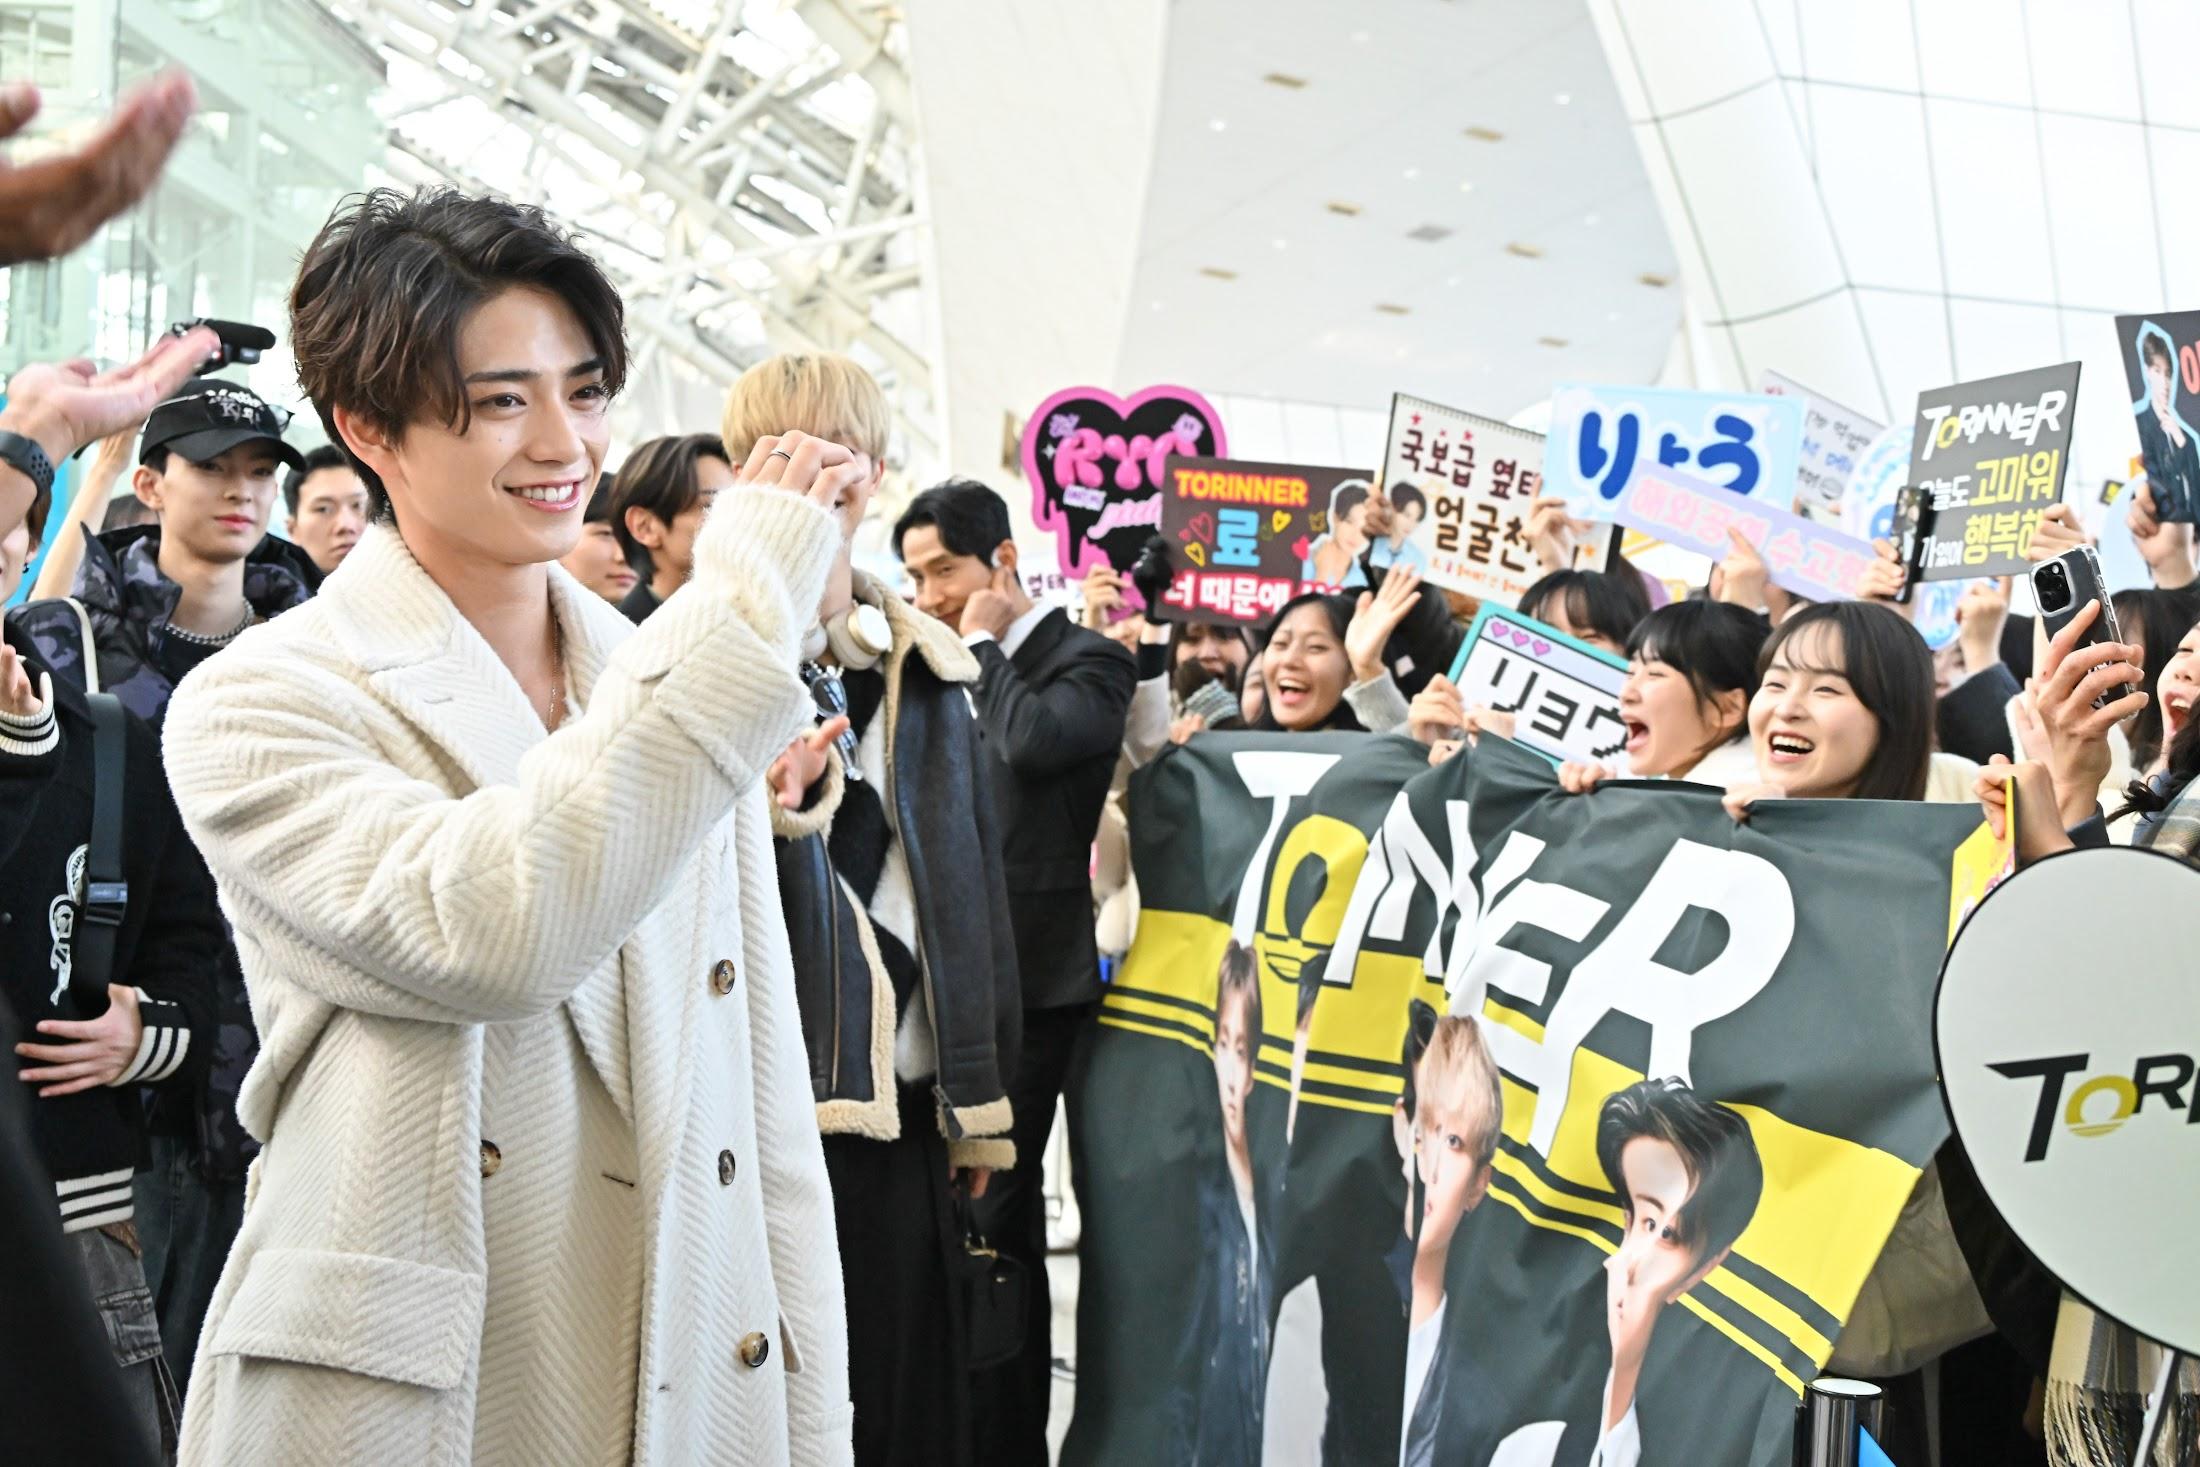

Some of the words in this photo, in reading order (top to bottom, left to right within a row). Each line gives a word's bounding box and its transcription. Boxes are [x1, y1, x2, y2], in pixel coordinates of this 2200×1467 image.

[1921, 390, 2068, 461] TORINNER
[1173, 469, 1309, 507] TORINNER
[1401, 429, 1475, 489] 국보급
[1969, 449, 2060, 507] 고마워
[1212, 508, 1260, 567] 료
[1435, 496, 1552, 573] 얼굴천
[1200, 576, 1292, 617] 때문에
